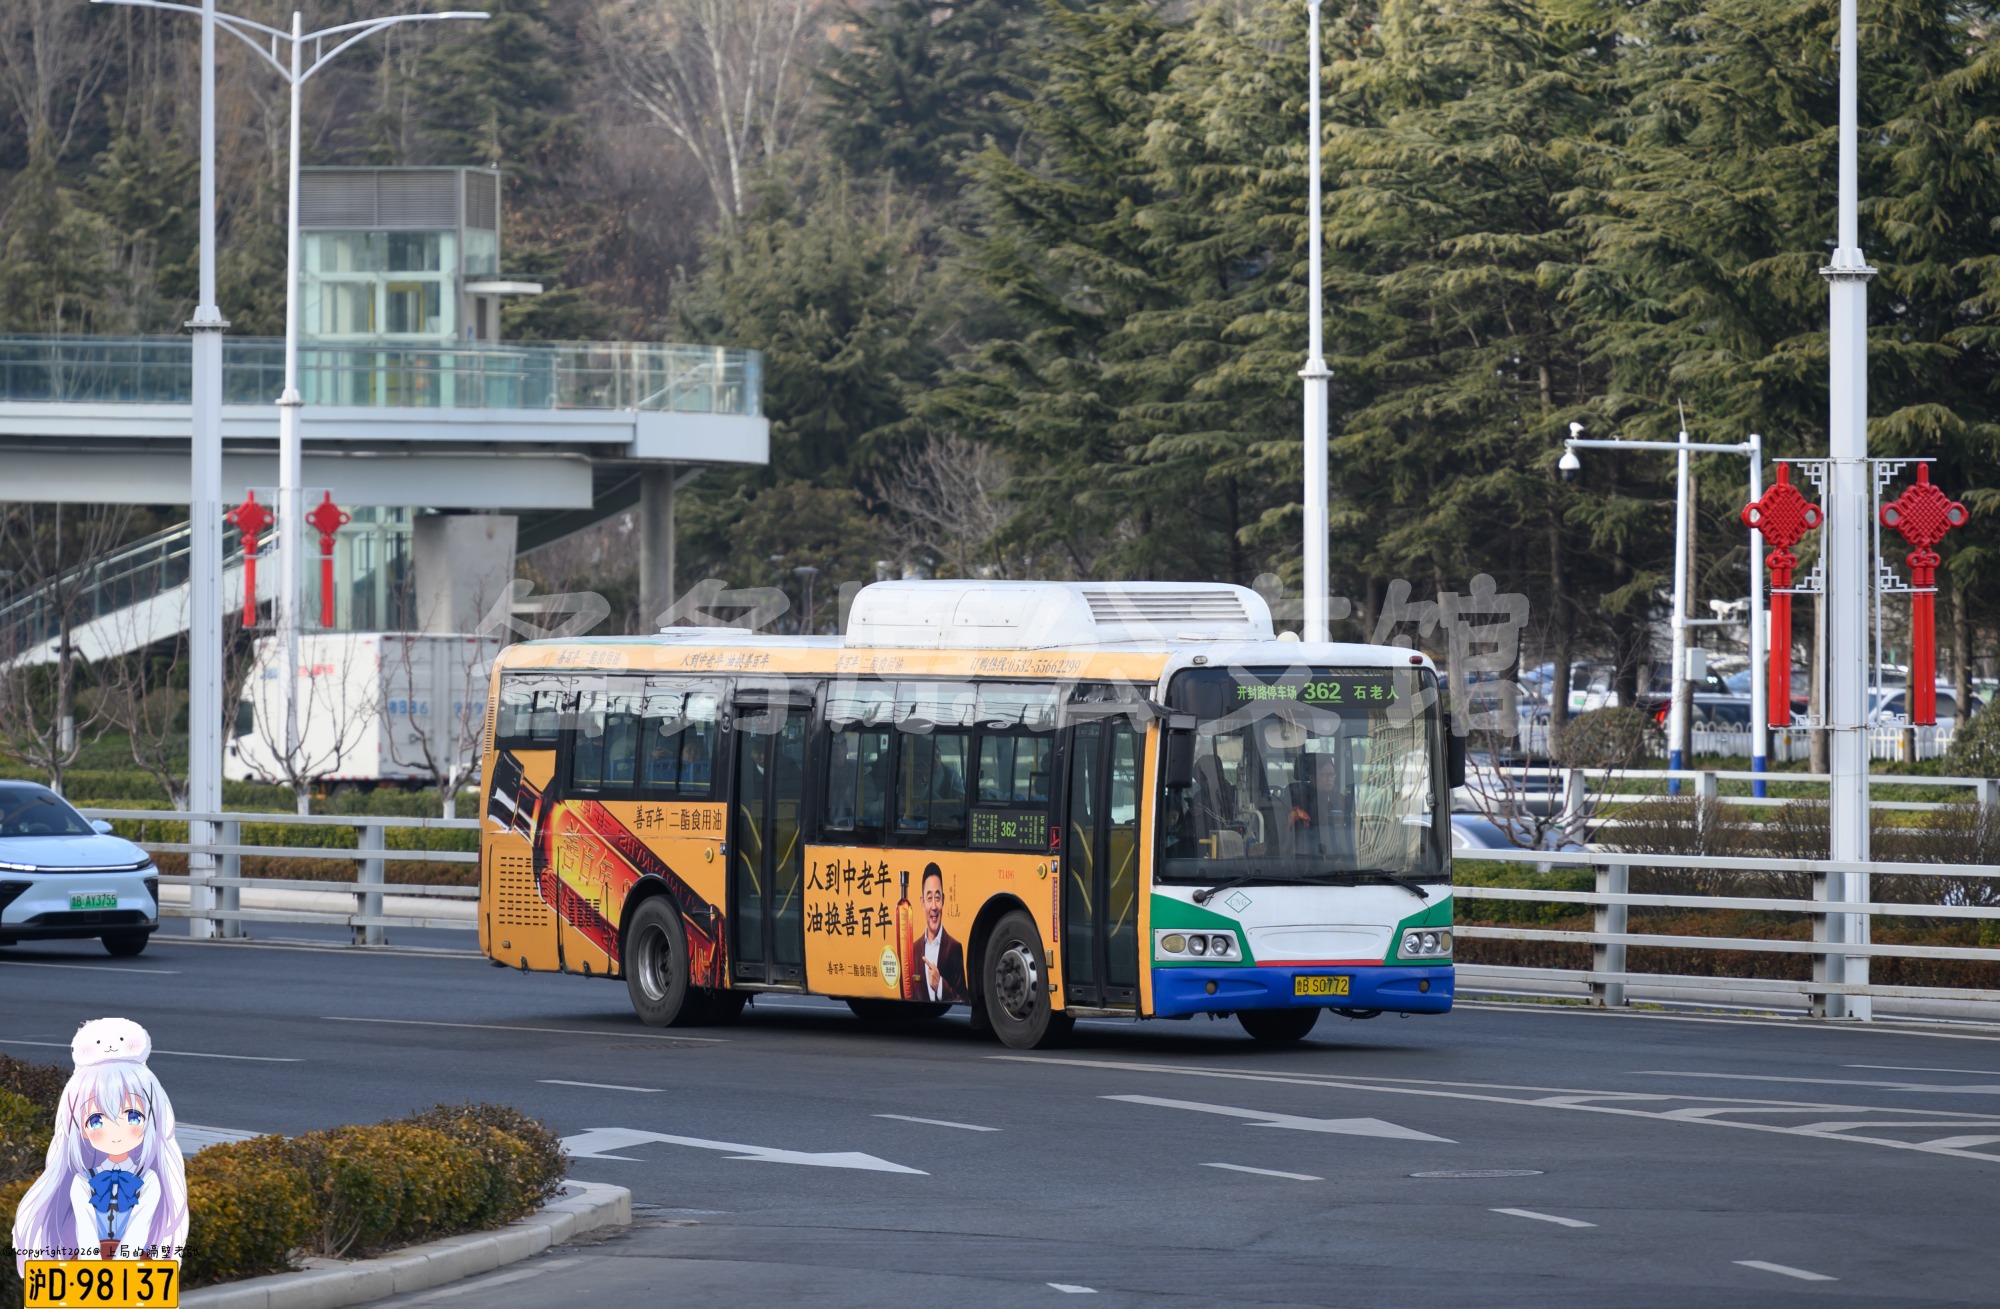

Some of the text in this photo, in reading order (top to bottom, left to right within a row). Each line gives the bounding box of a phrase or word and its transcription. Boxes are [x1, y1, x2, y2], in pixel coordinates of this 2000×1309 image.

[1237, 682, 1400, 700] 开封路停车场 362 石老人
[633, 804, 665, 831] 善百年
[669, 808, 722, 831] 二酯食用油
[1000, 822, 1017, 838] 362
[806, 858, 892, 899] 人到中老年
[1229, 897, 1247, 907] CNG
[806, 900, 893, 941] 油换善百年
[827, 960, 845, 976] 善百年
